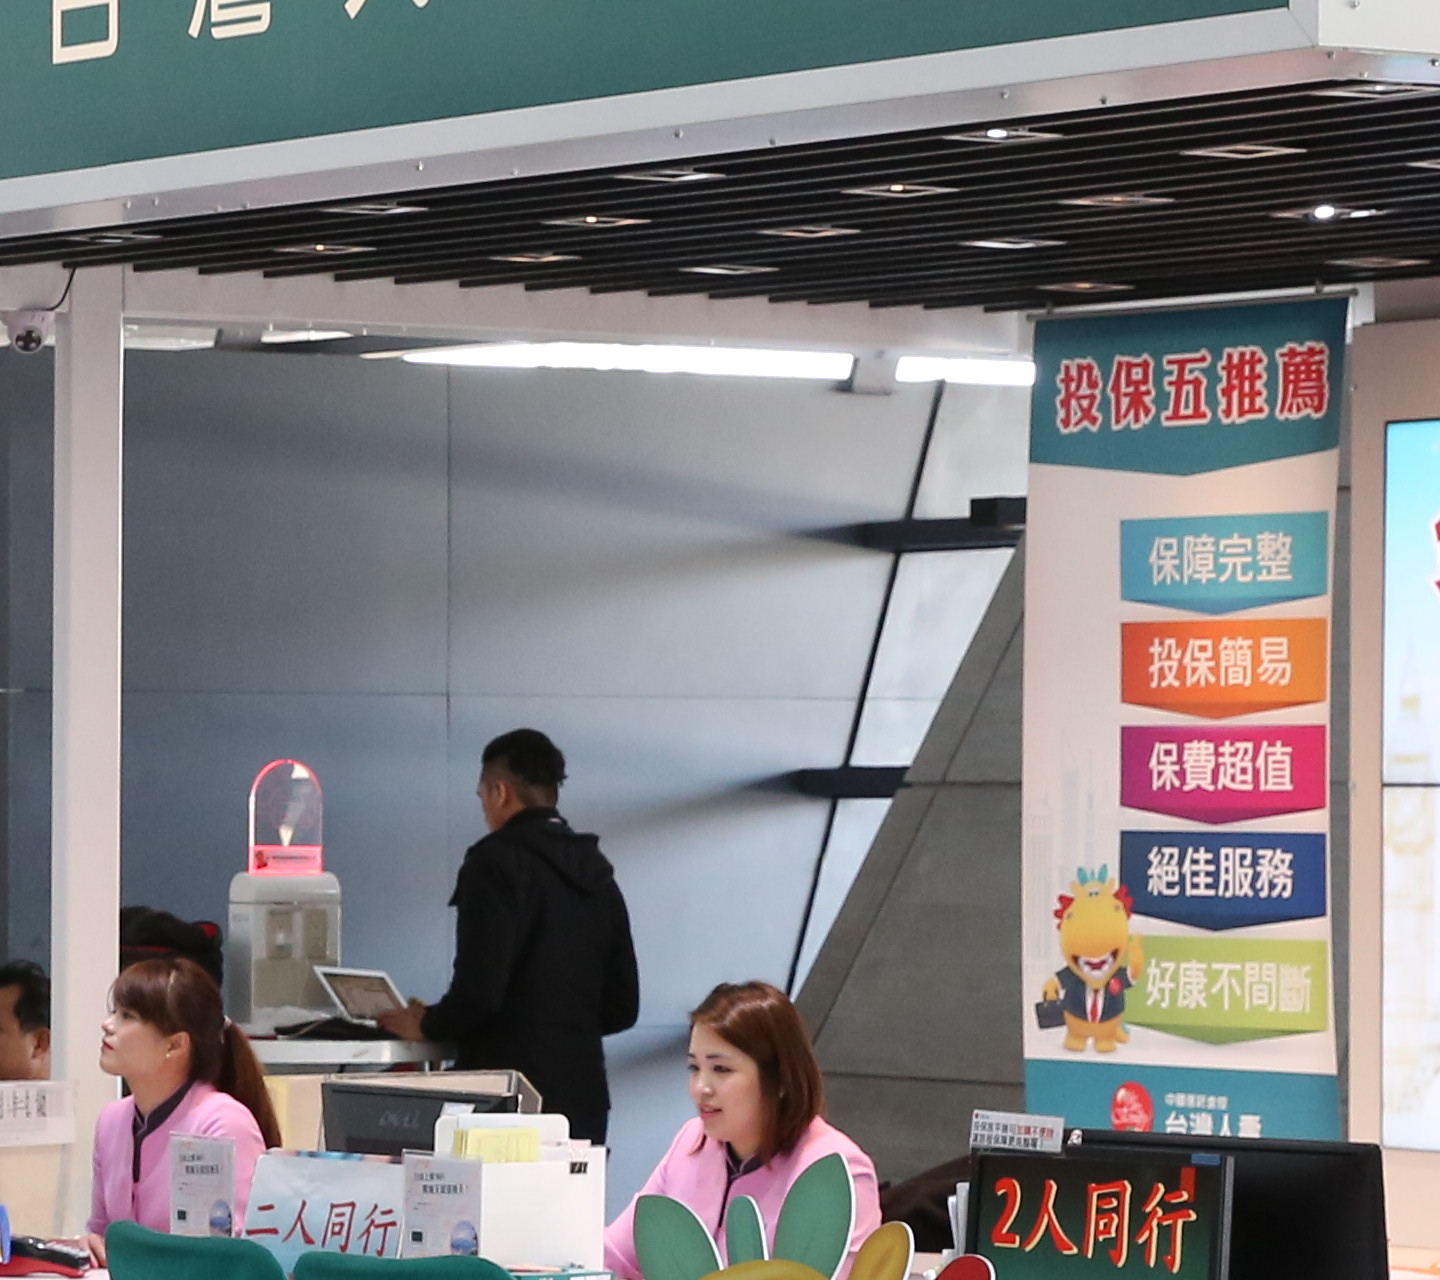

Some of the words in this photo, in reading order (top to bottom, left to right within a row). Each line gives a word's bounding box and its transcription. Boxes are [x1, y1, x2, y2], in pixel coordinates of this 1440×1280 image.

[1054, 337, 1332, 433] 投保五推薦
[1148, 530, 1294, 587] 保障完整
[1148, 634, 1294, 691] 投保簡易
[1147, 739, 1295, 793] 保費超值
[1146, 845, 1295, 901] 絕佳服務
[1145, 958, 1312, 1016] 好康不間斷
[244, 1198, 400, 1258] 二人同行
[990, 1176, 1199, 1274] 2人同行
